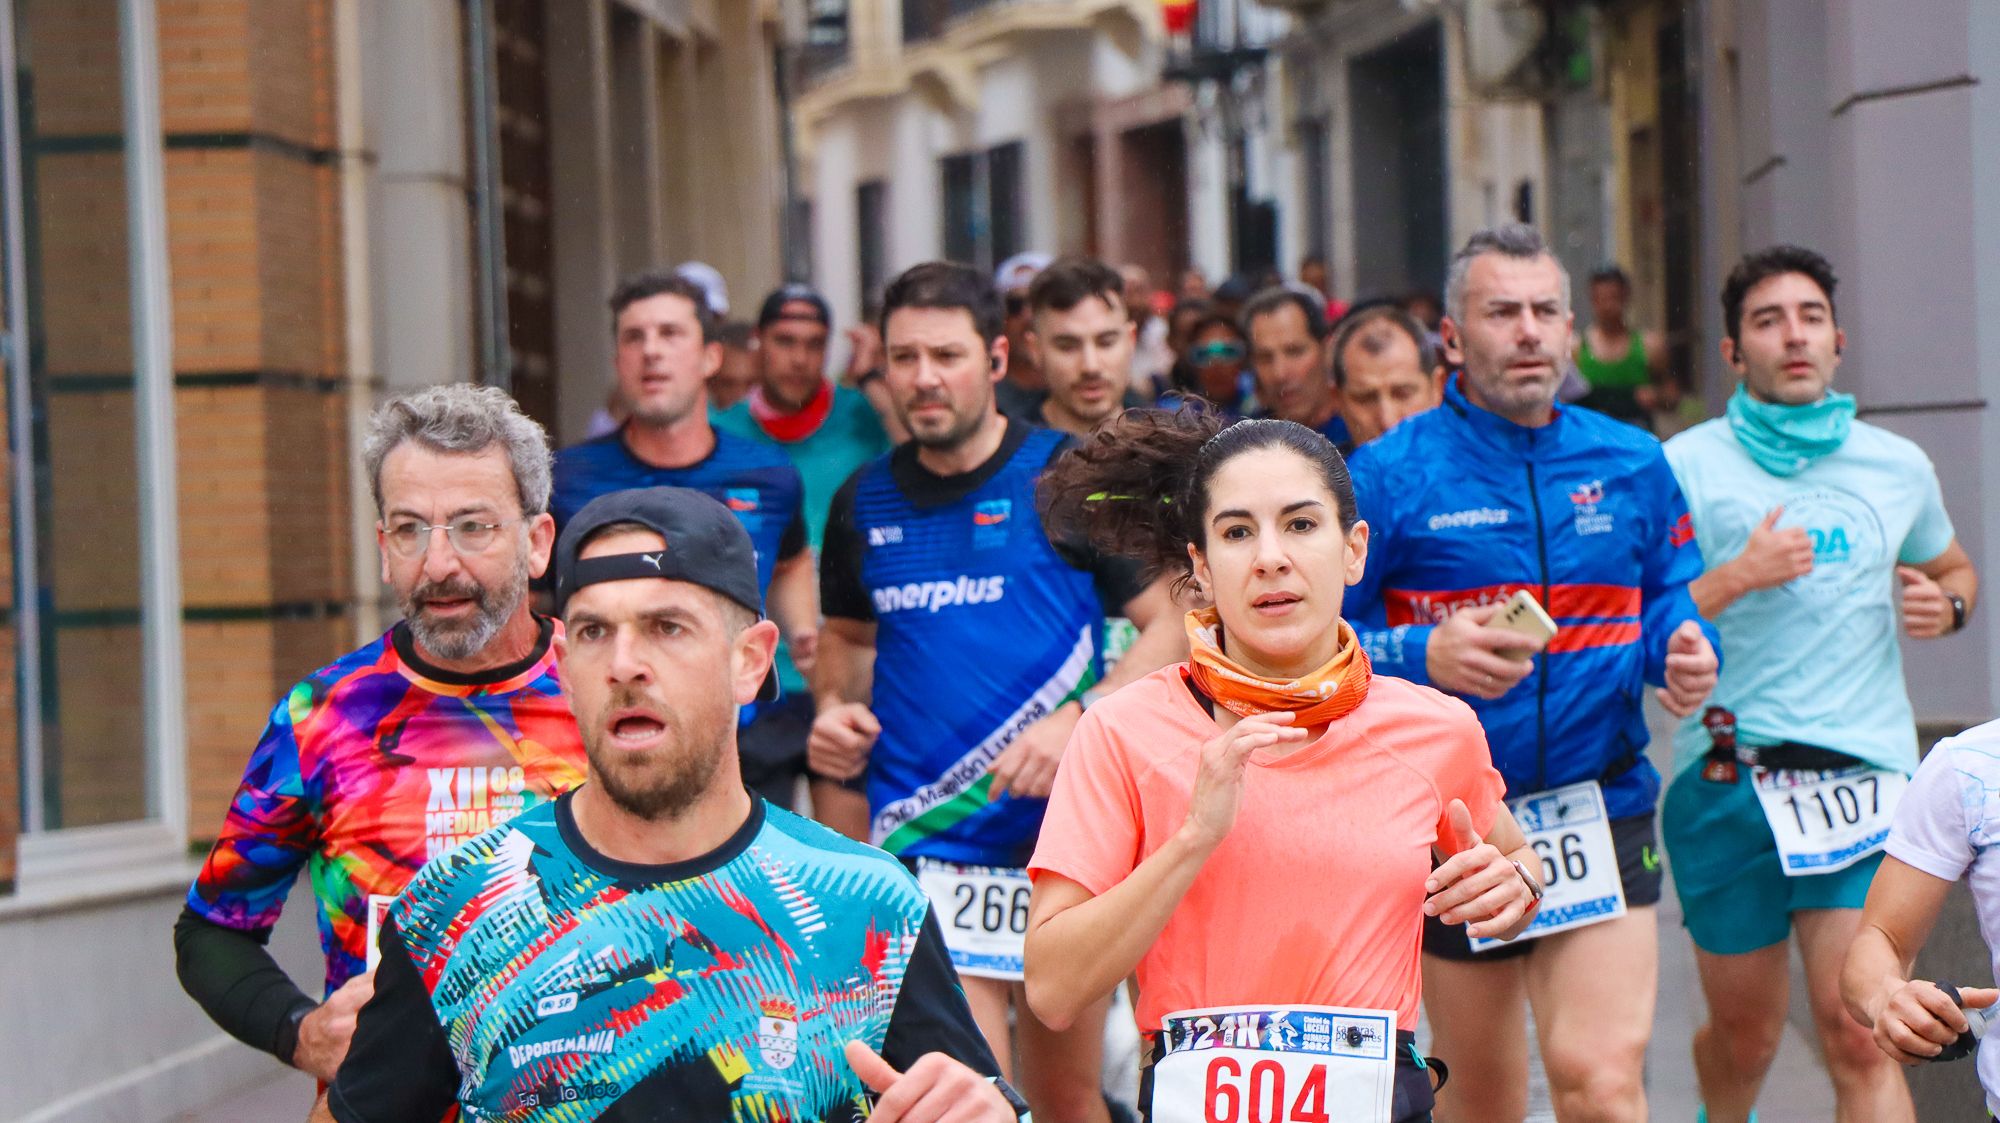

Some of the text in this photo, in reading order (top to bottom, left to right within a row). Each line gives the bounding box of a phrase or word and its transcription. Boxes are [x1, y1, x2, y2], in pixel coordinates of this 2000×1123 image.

[426, 766, 487, 811] XII
[490, 766, 526, 793] 08
[491, 794, 525, 807] MARZO
[1784, 776, 1878, 834] 1107
[425, 810, 490, 836] MEDIA
[954, 884, 1031, 933] 266
[1304, 1022, 1330, 1034] LUCENA
[509, 1029, 615, 1069] DEPORTEMANIA
[1204, 1056, 1329, 1123] 604
